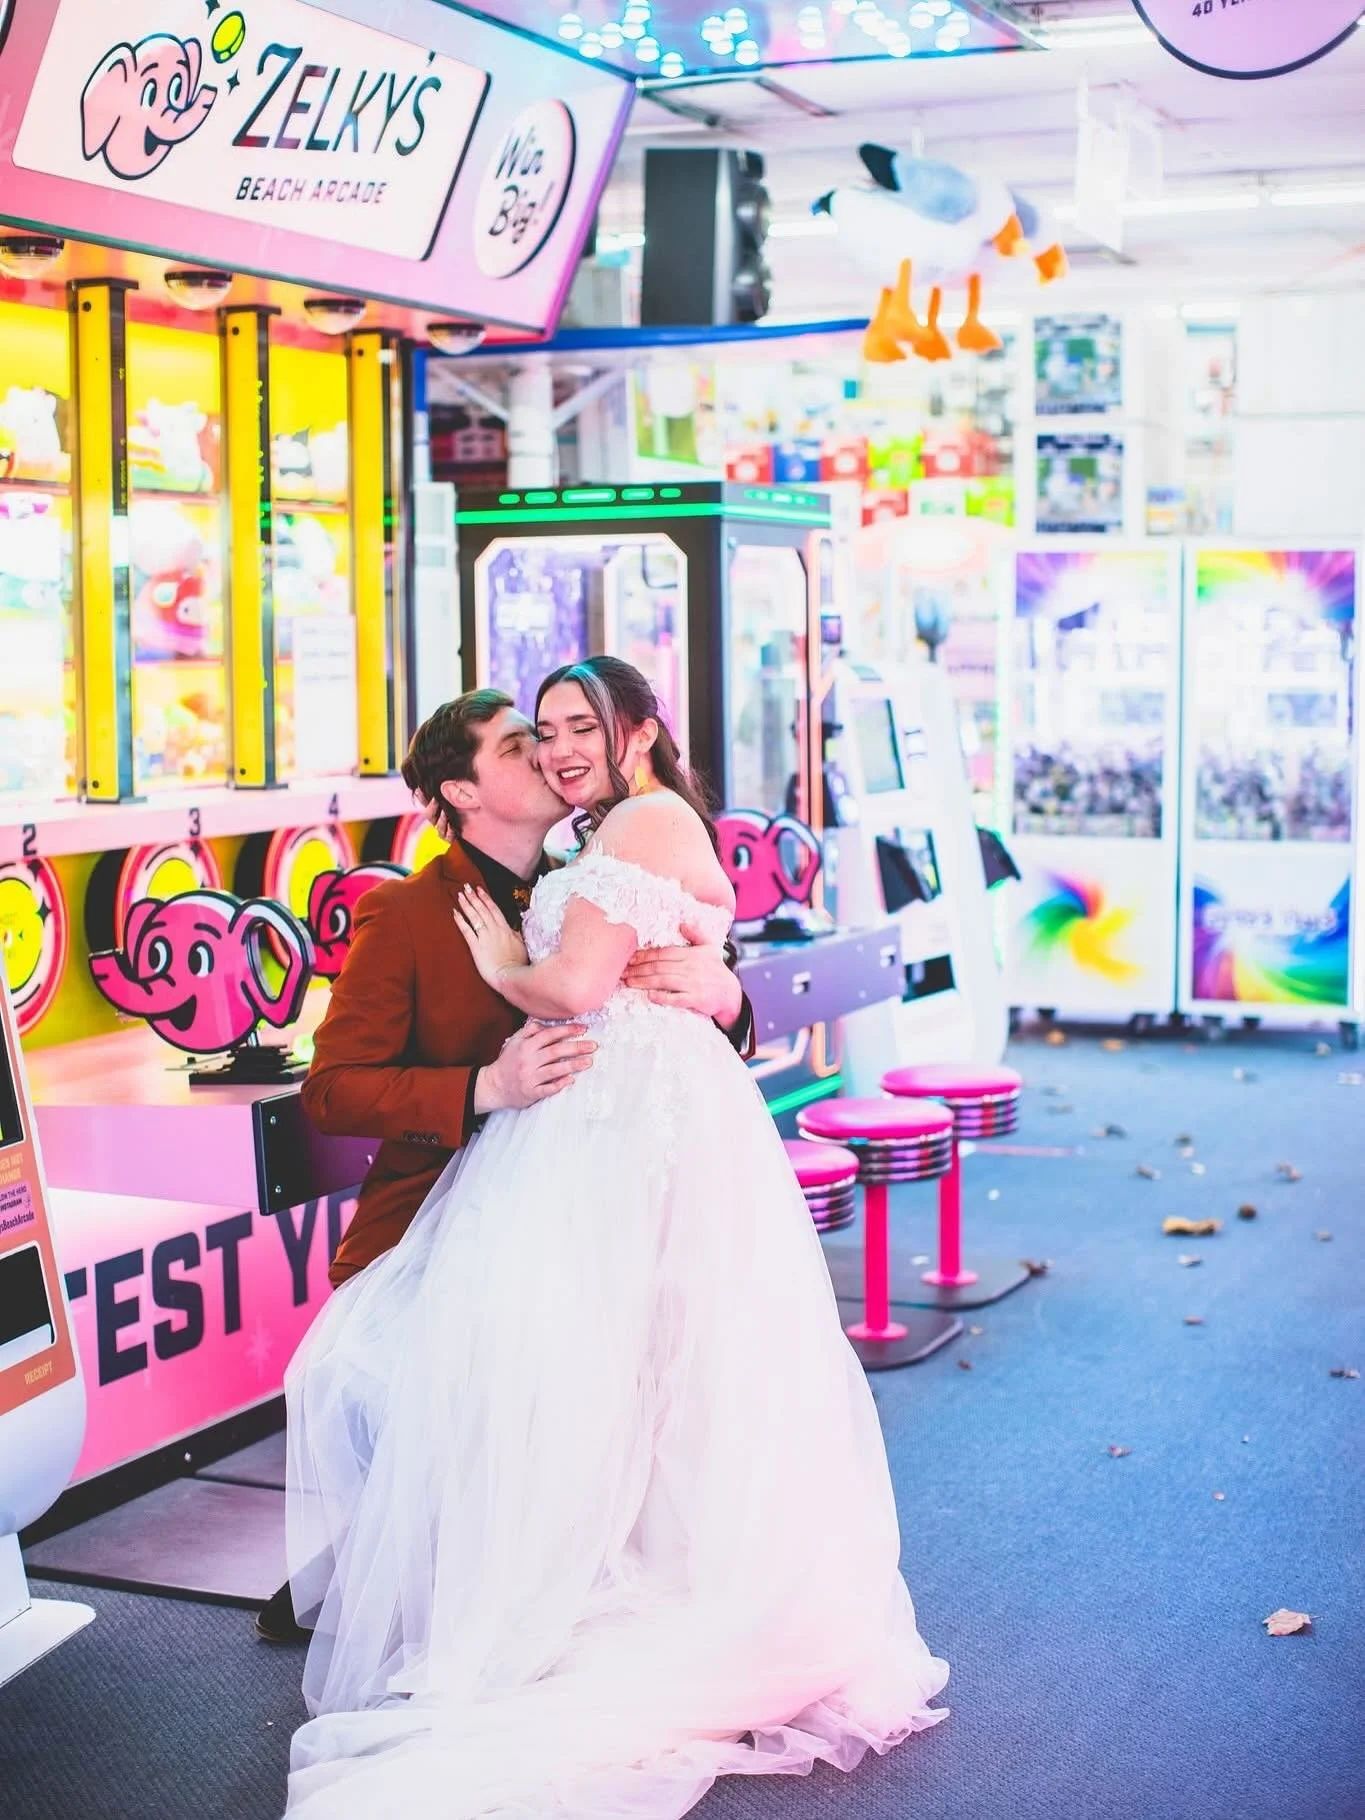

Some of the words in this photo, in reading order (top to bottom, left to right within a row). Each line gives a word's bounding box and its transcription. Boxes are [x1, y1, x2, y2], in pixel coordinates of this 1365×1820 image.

[1192, 0, 1213, 17] 40
[232, 42, 442, 156] ZELKY'S
[495, 126, 544, 179] Win
[236, 177, 306, 201] BEACH
[309, 180, 388, 203] ARCADE
[488, 182, 555, 244] Big!
[328, 793, 339, 818] 4
[188, 808, 201, 837] 3
[22, 823, 37, 857] 2
